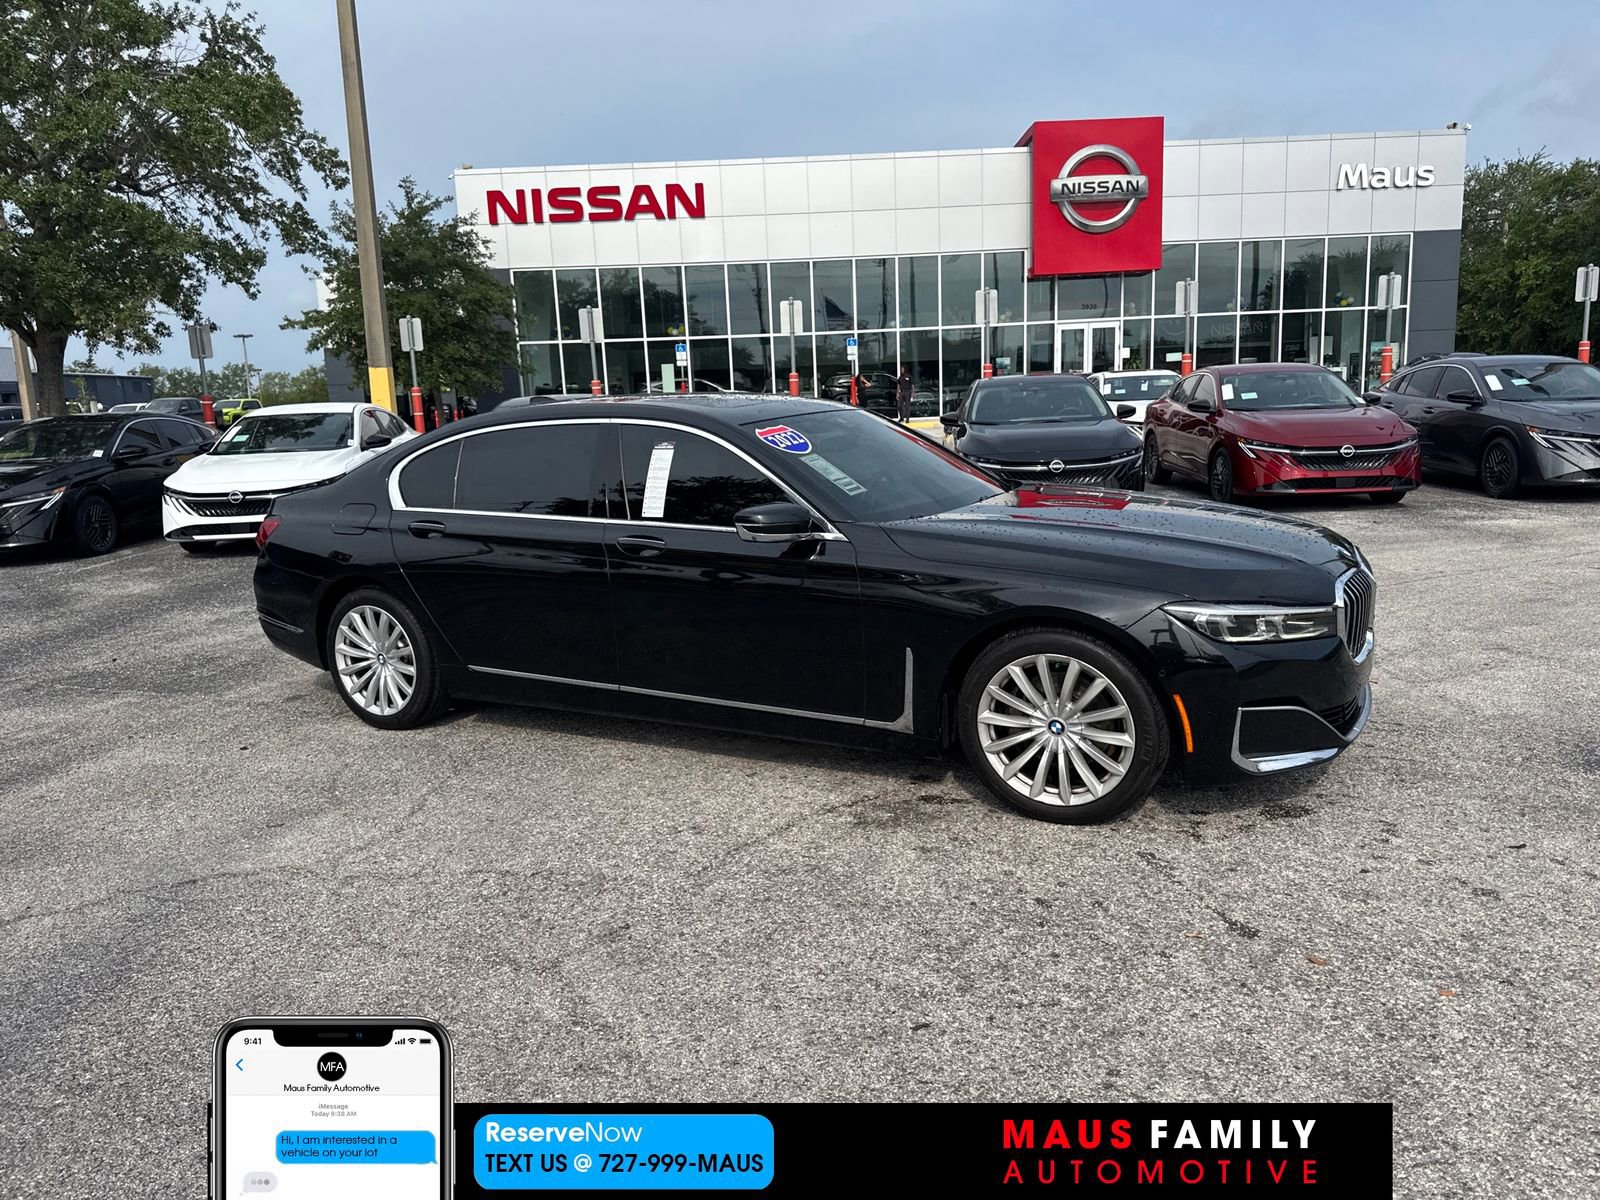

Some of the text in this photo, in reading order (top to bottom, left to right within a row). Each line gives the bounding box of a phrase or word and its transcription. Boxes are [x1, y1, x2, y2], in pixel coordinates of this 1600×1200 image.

[1061, 179, 1140, 195] NISSAN
[1337, 163, 1435, 191] Maus
[486, 182, 705, 225] NISSAN
[767, 431, 806, 448] 2022
